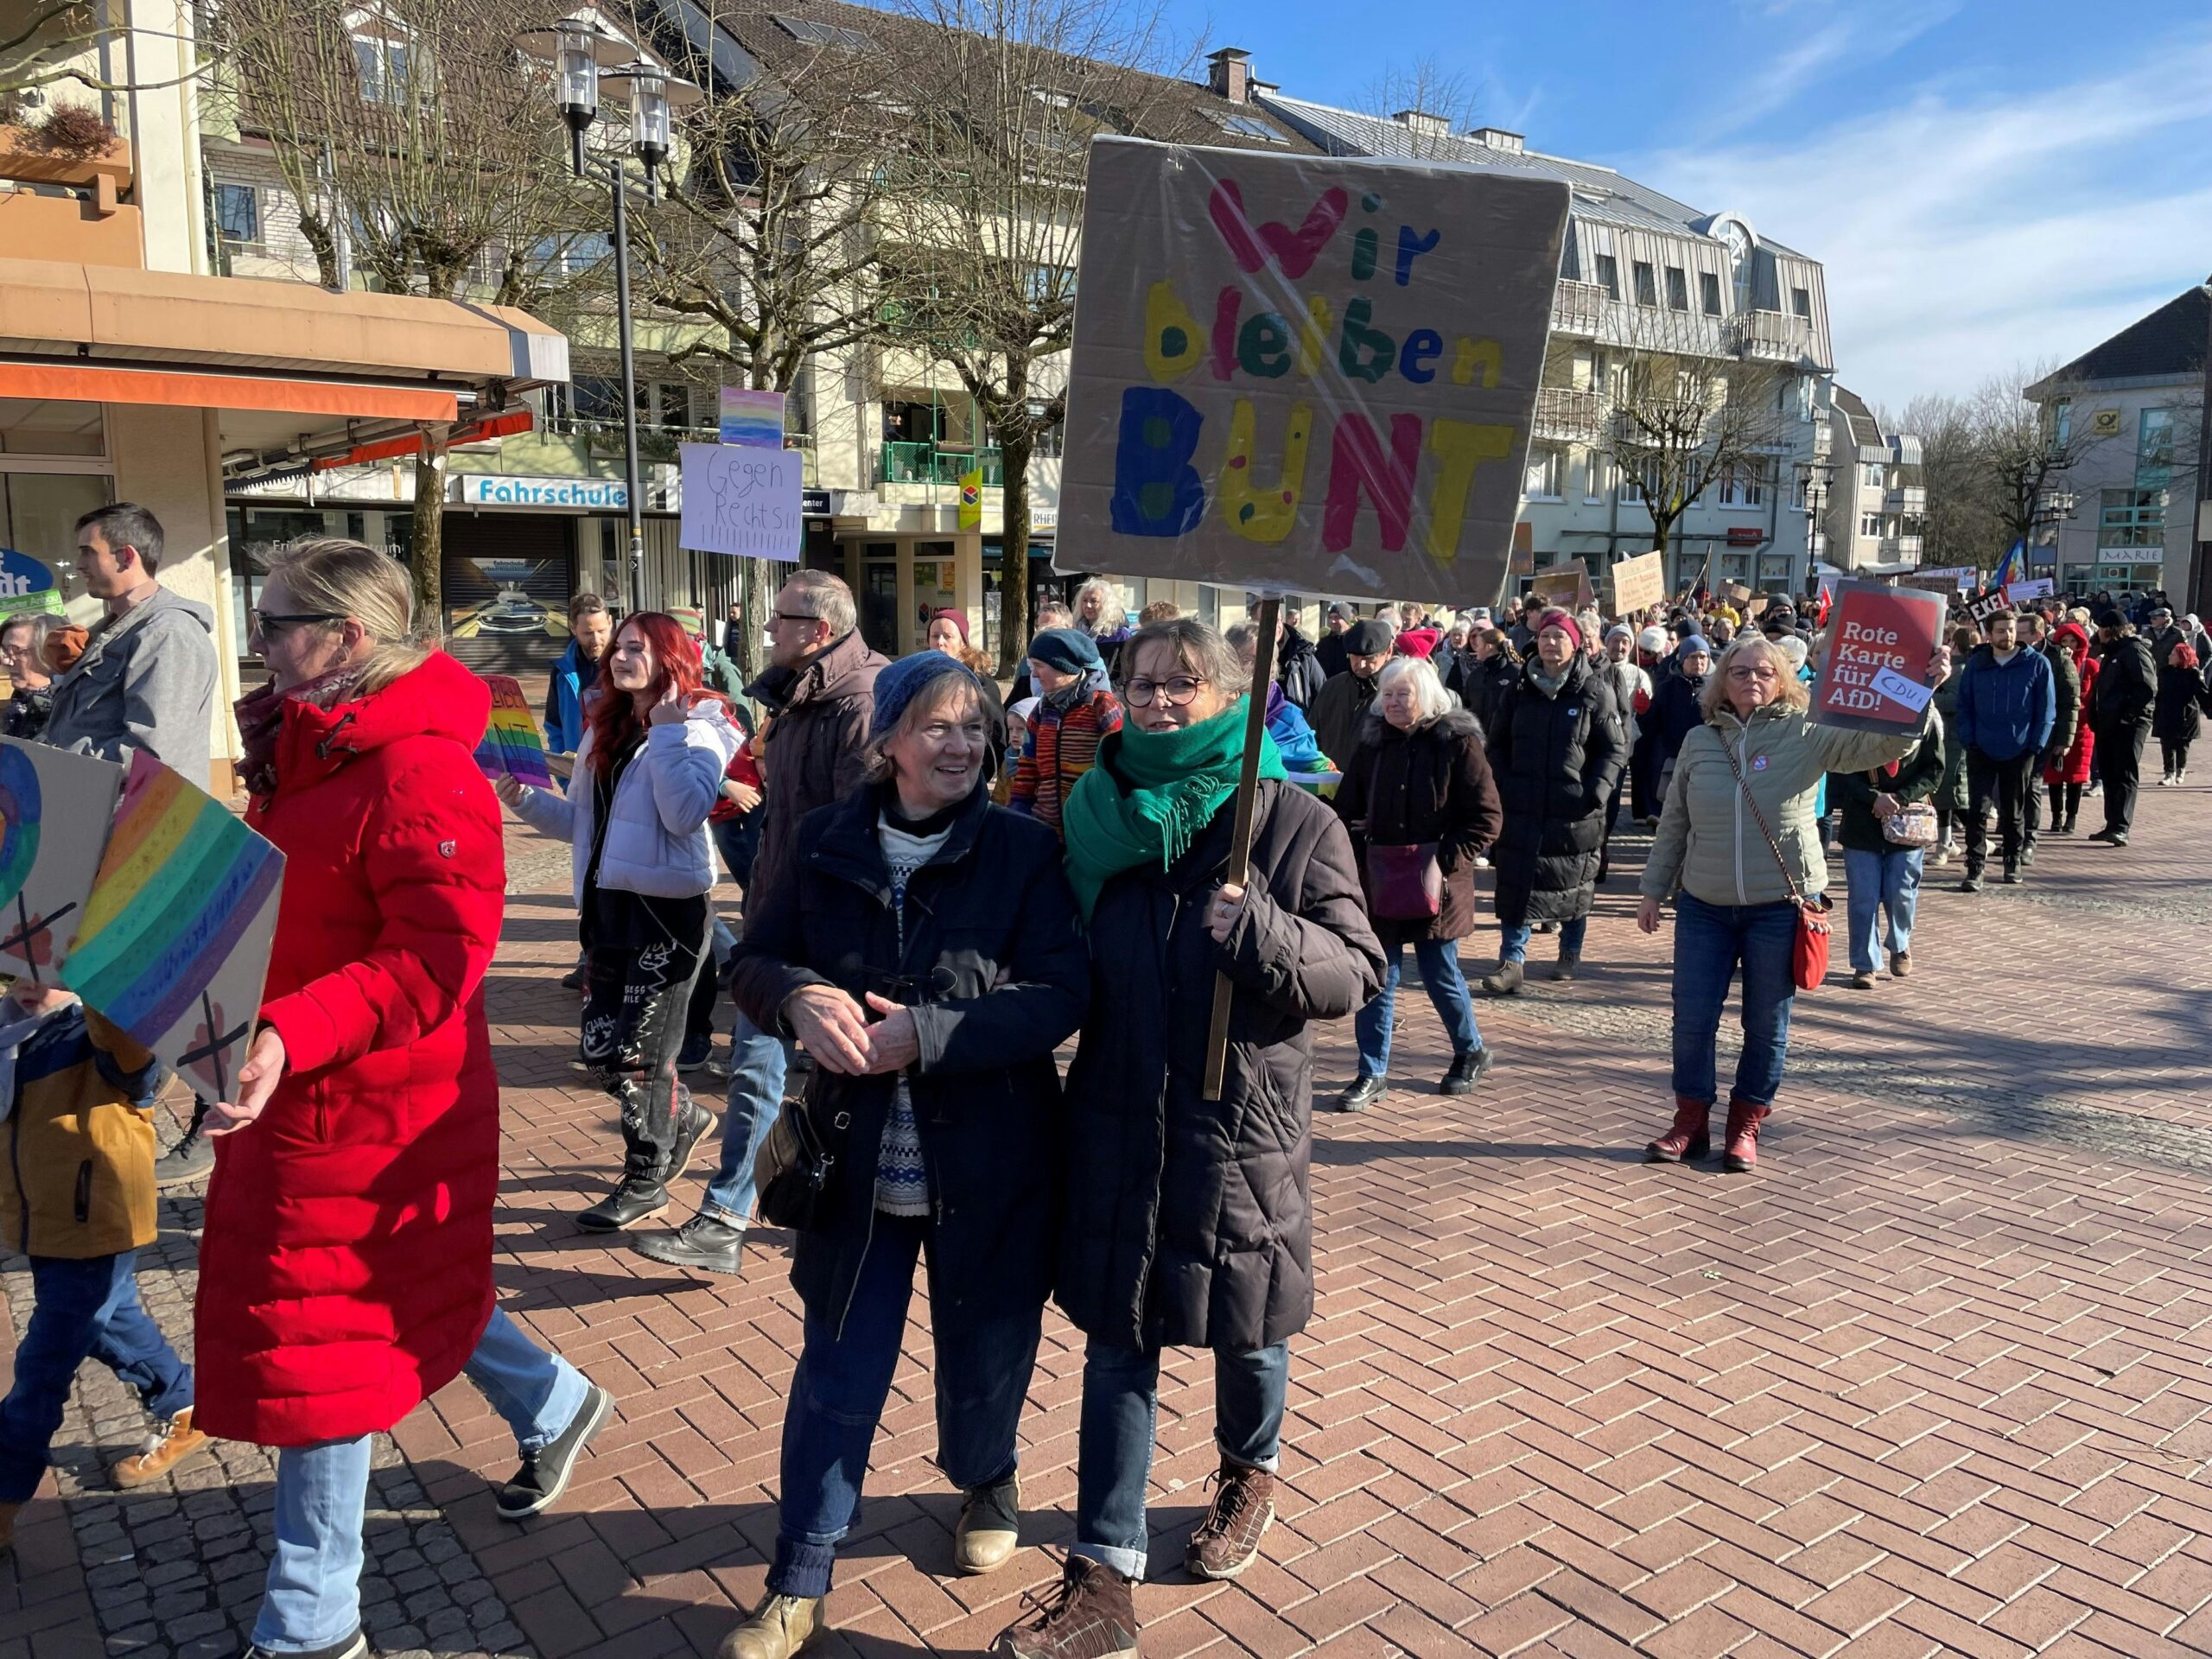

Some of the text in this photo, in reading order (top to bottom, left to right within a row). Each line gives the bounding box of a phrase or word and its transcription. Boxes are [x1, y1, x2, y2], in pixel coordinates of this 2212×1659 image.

[1209, 178, 1440, 286] Wir
[1143, 278, 1503, 389] bleiben
[707, 450, 783, 499] Gegen
[1110, 386, 1516, 559] BUNT
[480, 480, 628, 506] Fahrschule
[2104, 550, 2158, 561] MARIE
[1969, 591, 2009, 621] EKEL
[1842, 621, 1897, 645] Rote
[1837, 643, 1905, 670] Karte
[1832, 664, 1871, 686] für
[1827, 687, 1882, 711] AfD!
